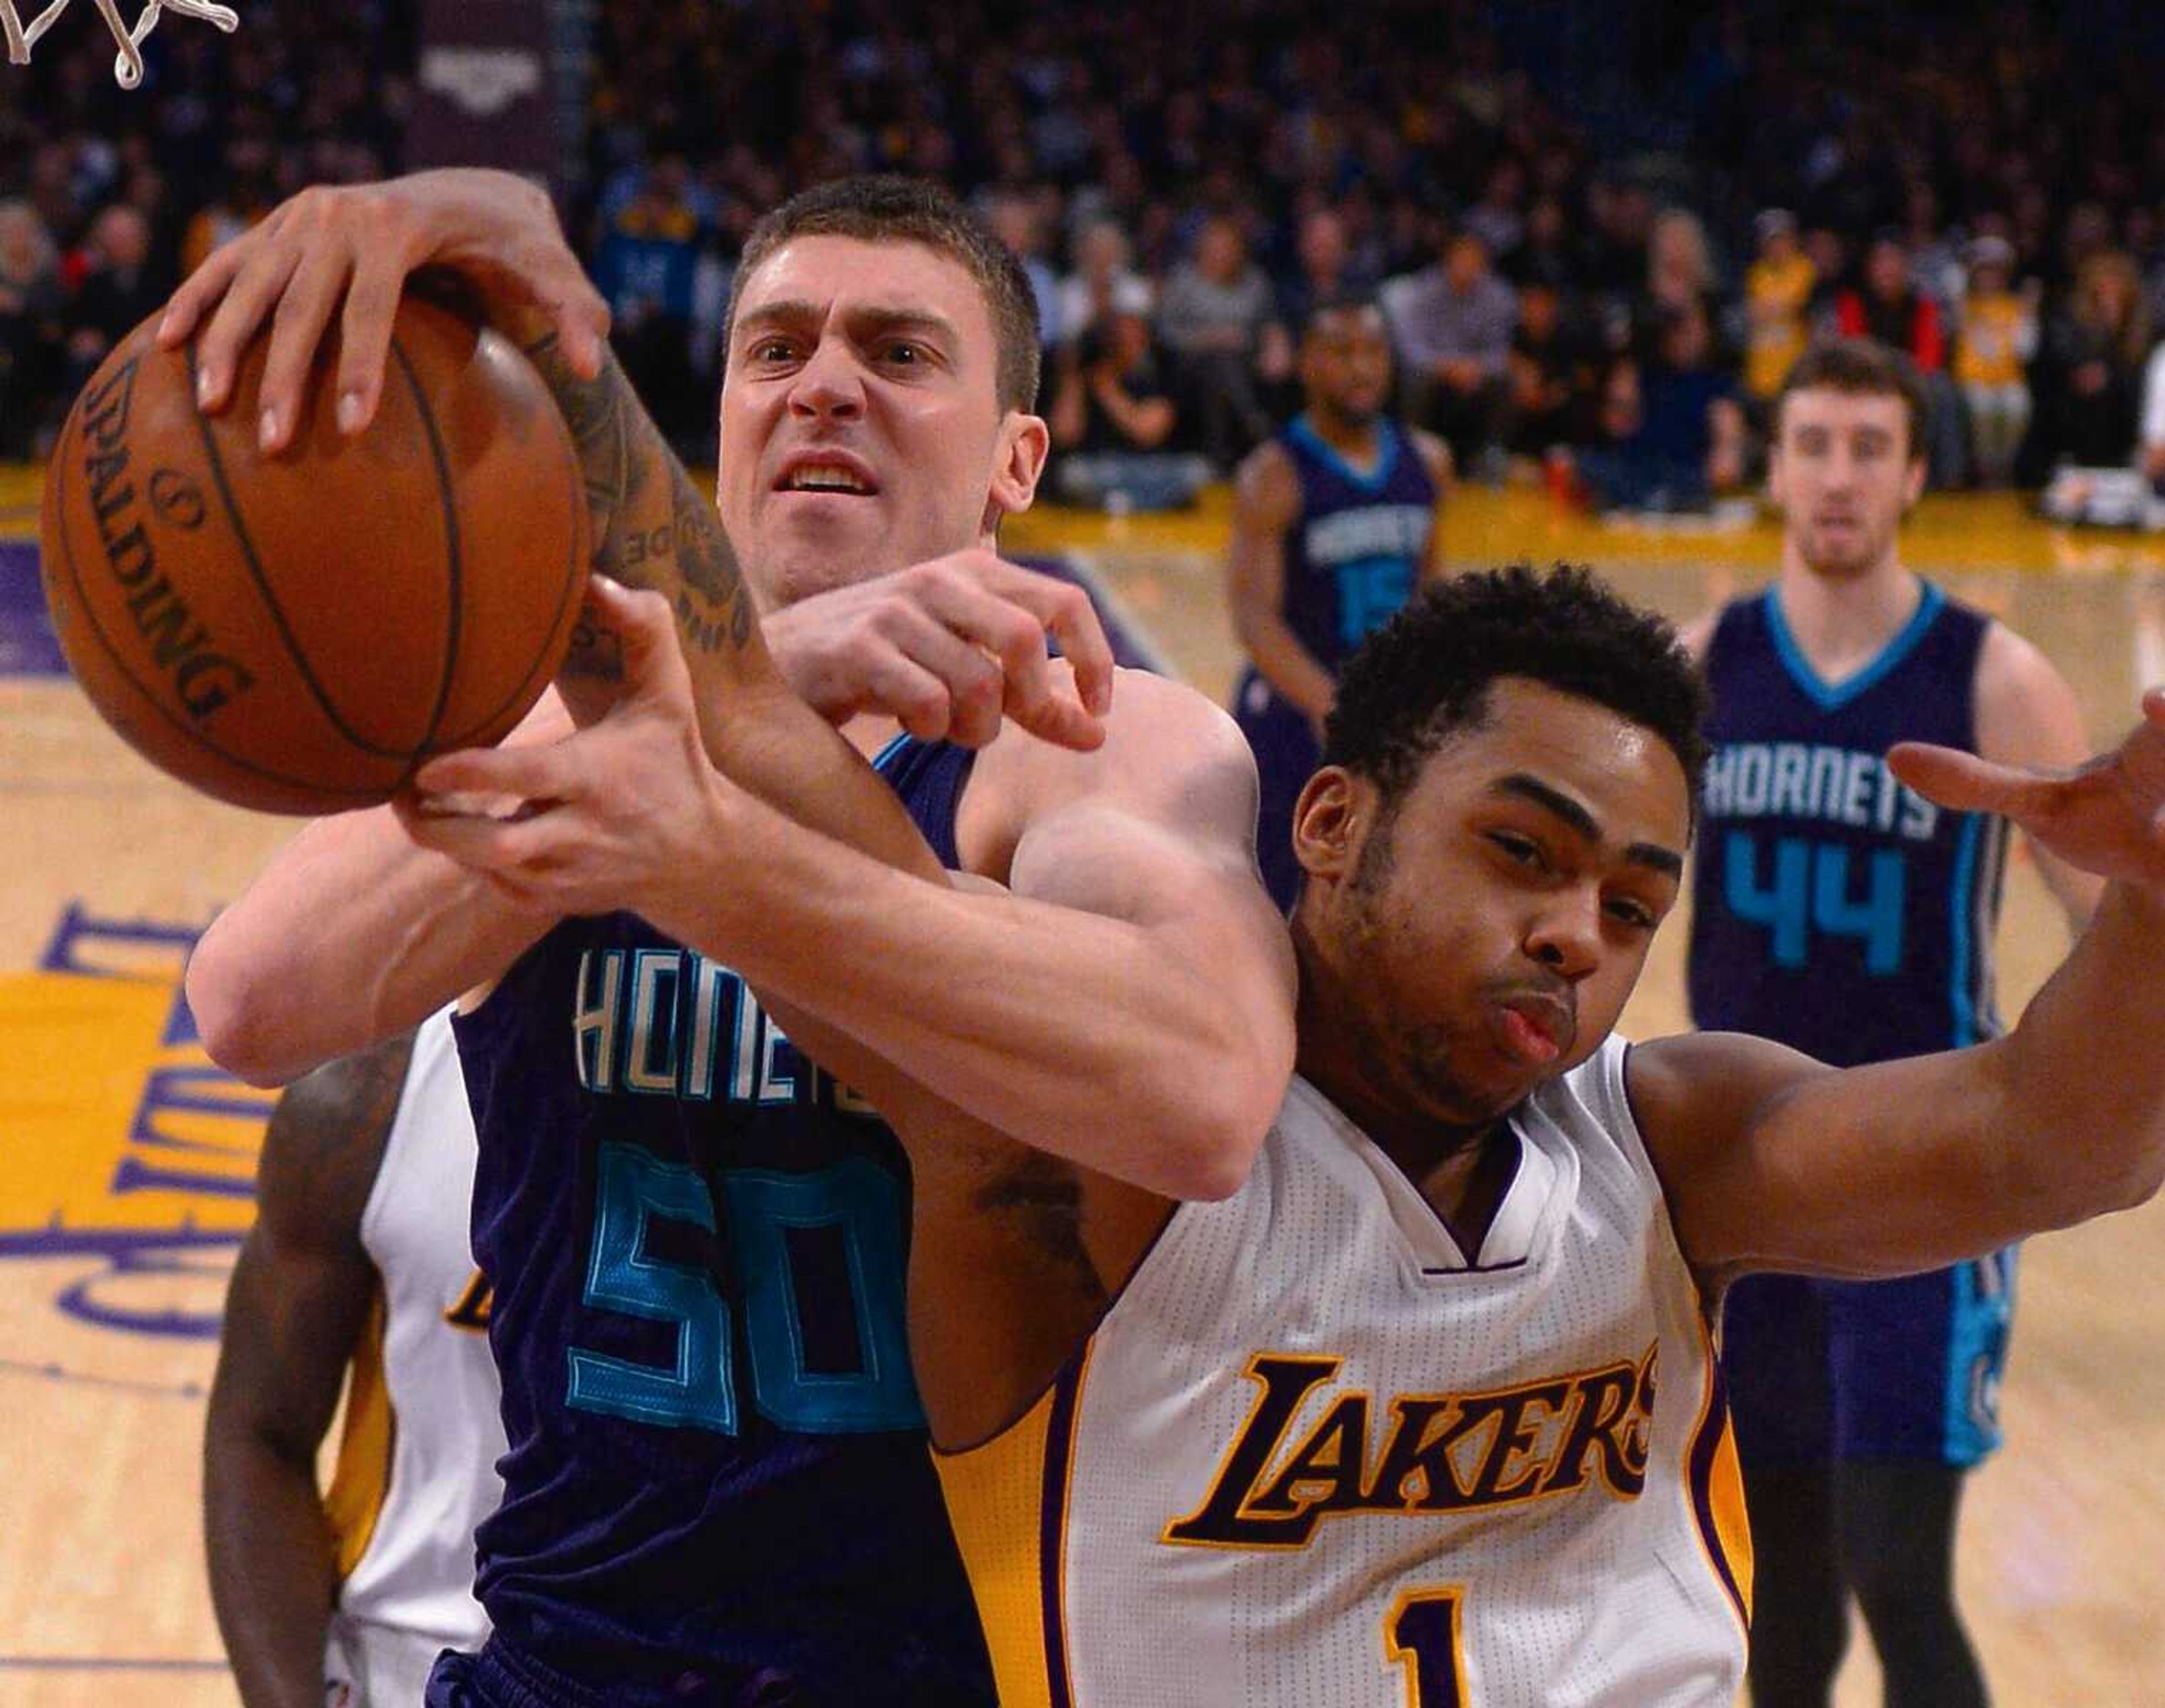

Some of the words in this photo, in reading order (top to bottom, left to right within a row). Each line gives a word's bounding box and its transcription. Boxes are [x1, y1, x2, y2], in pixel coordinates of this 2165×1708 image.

[1702, 742, 1937, 841] HORNETS
[1725, 830, 1908, 977] 44
[564, 1139, 929, 1437] 50
[1382, 1583, 1468, 1708] 1
